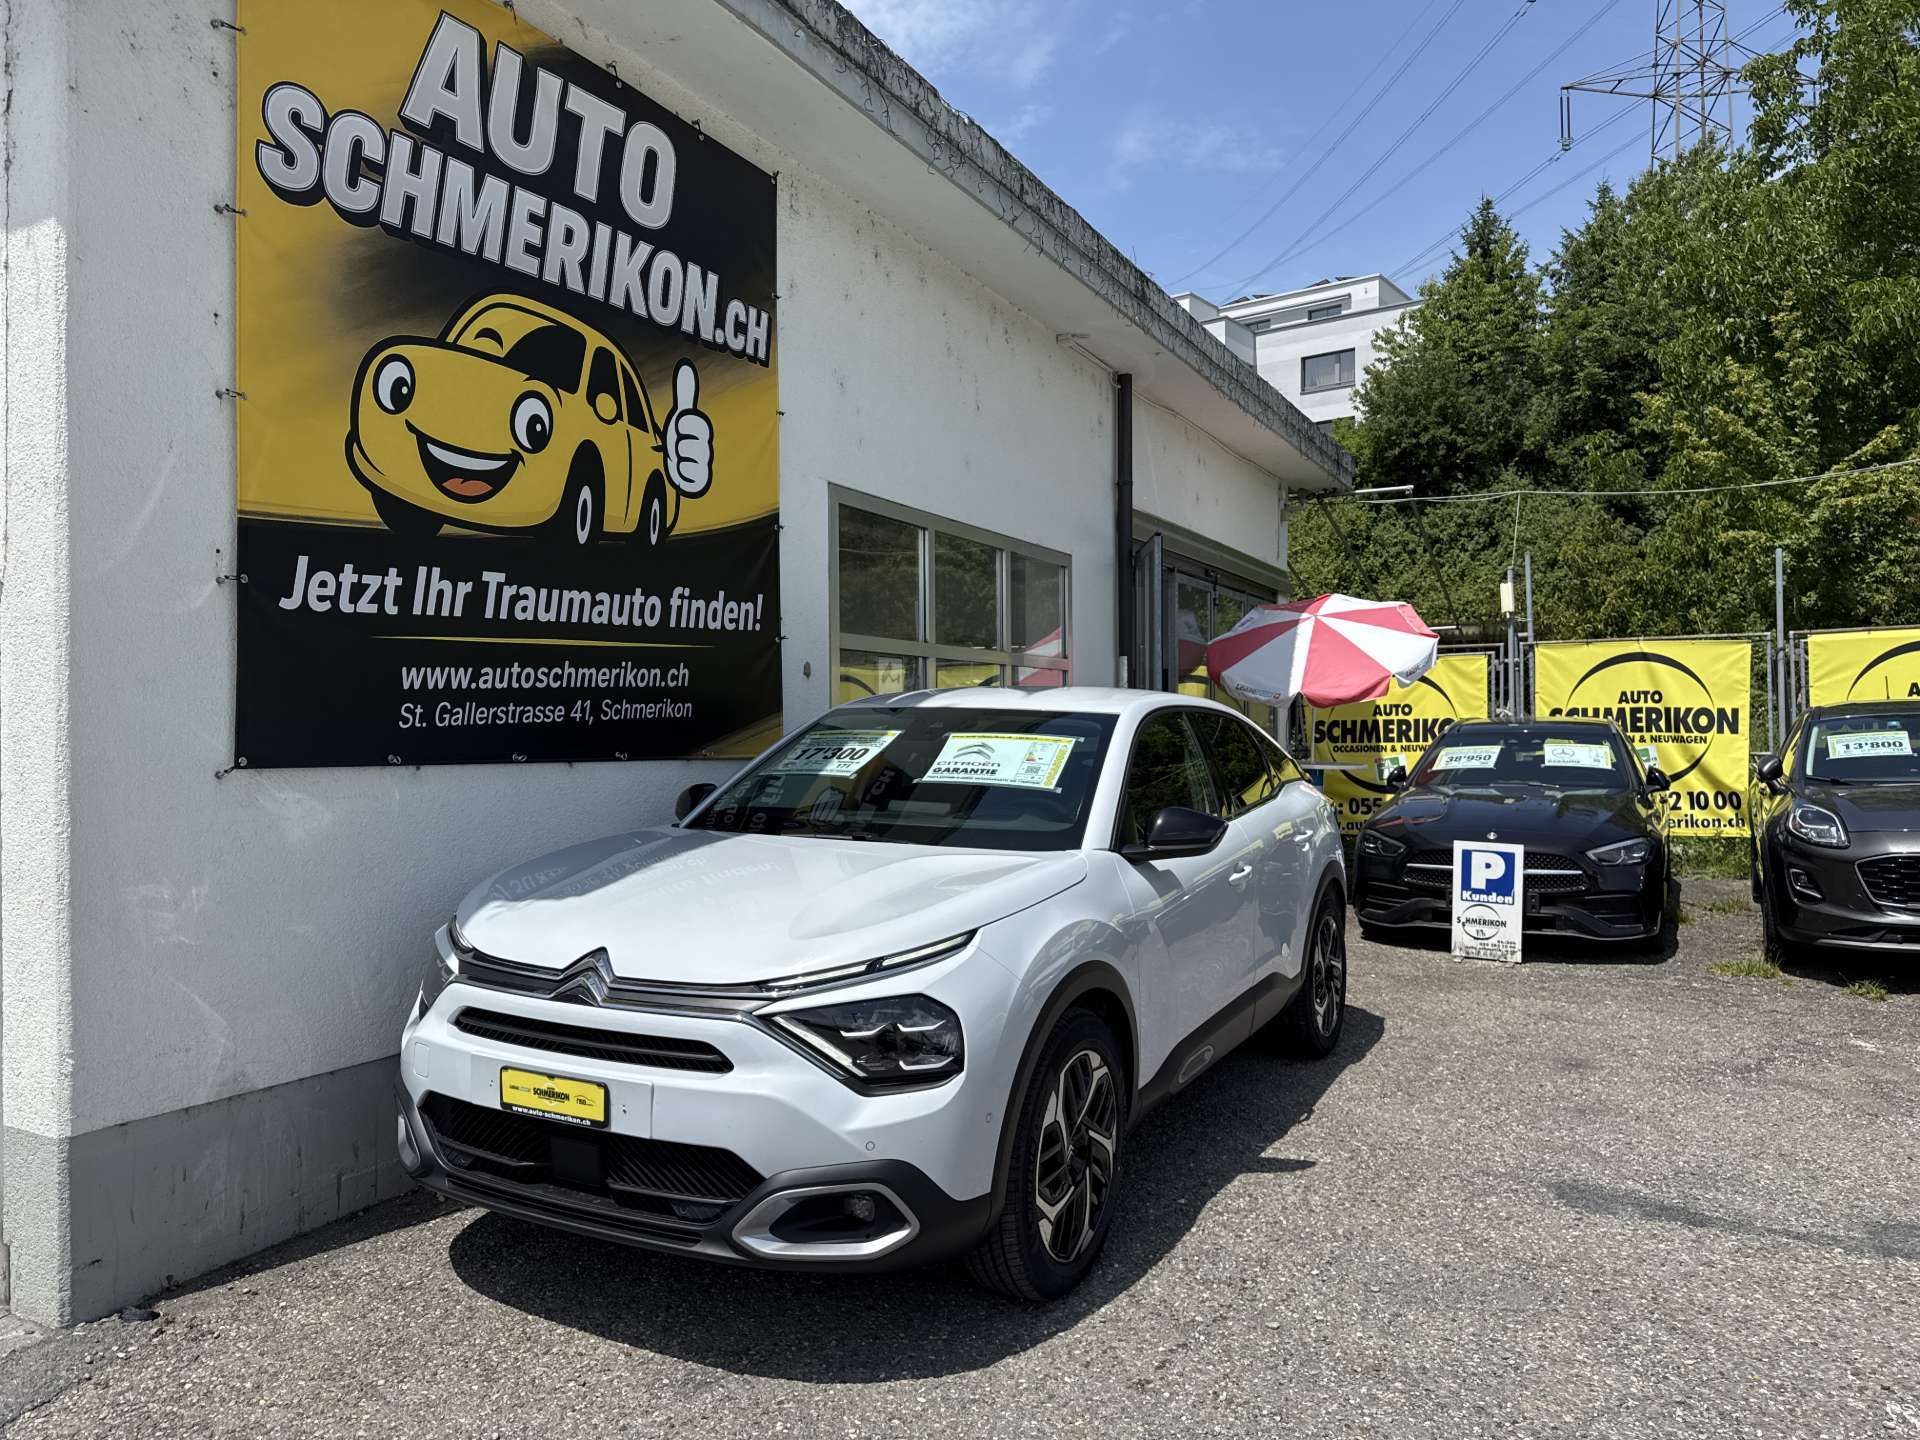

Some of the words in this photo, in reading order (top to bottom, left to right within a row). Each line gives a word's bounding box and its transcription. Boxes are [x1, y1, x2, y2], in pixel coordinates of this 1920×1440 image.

[400, 11, 676, 230] AUTO
[256, 83, 770, 364] SCHMERIKON.CH
[278, 555, 402, 615] Jetzt
[412, 566, 473, 618] Ihr
[482, 571, 661, 628] Traumauto
[670, 586, 764, 631] finden!
[401, 660, 689, 690] www.autoschmerikon.ch
[1618, 690, 1663, 705] AUTO
[398, 704, 427, 728] St.
[435, 701, 566, 728] Gallerstrasse
[570, 701, 593, 724] 41,
[601, 699, 693, 721] Schmerikon
[1372, 703, 1413, 717] AUTO
[1639, 735, 1647, 744] &
[1650, 735, 1708, 745] NEUWAGEN
[1842, 741, 1904, 750] 13'800
[794, 747, 871, 760] 17'300
[1332, 744, 1388, 753] OCCASIONEN
[1390, 744, 1398, 753] &
[1400, 744, 1431, 753] NEUW
[1445, 754, 1492, 763] 38'950
[932, 767, 998, 775] GARANTIE
[1687, 791, 1709, 811] 10
[1713, 791, 1742, 811] 00
[1668, 812, 1746, 829] erikon.ch
[1470, 851, 1506, 890] P
[1462, 890, 1514, 905] Kunden
[533, 1087, 570, 1102] SCHMERIKON
[511, 1105, 591, 1126] www.auto-schmerikon.ch
